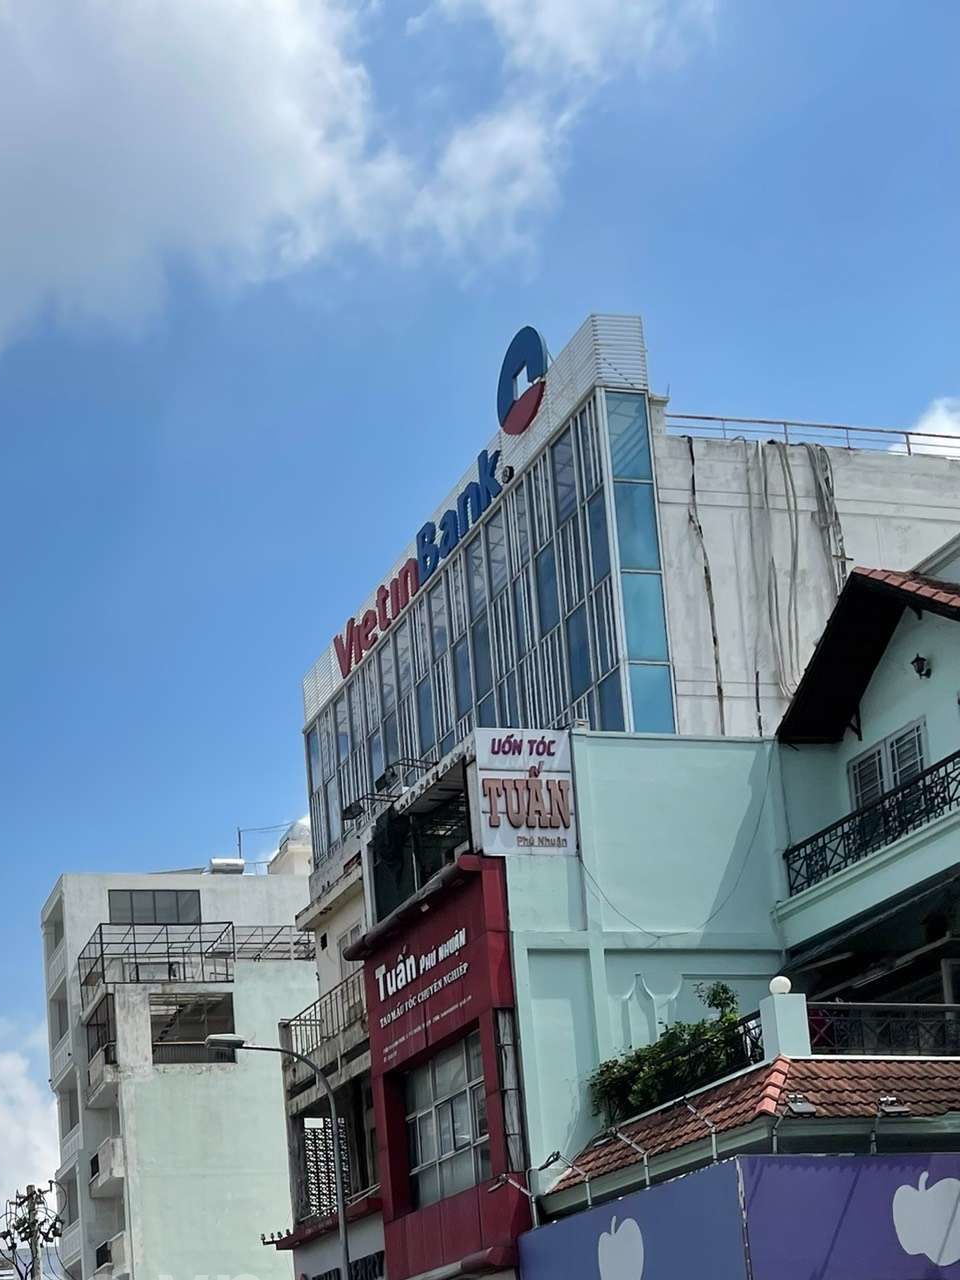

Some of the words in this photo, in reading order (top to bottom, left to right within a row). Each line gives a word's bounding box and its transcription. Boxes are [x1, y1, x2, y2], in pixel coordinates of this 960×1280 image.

[333, 449, 503, 680] VietinBank
[490, 734, 523, 756] UỐN
[527, 736, 557, 757] TÓC
[482, 761, 571, 829] TUẤN
[516, 836, 535, 848] Phú
[537, 836, 568, 849] Nhuận
[375, 944, 417, 1002] Tuấn
